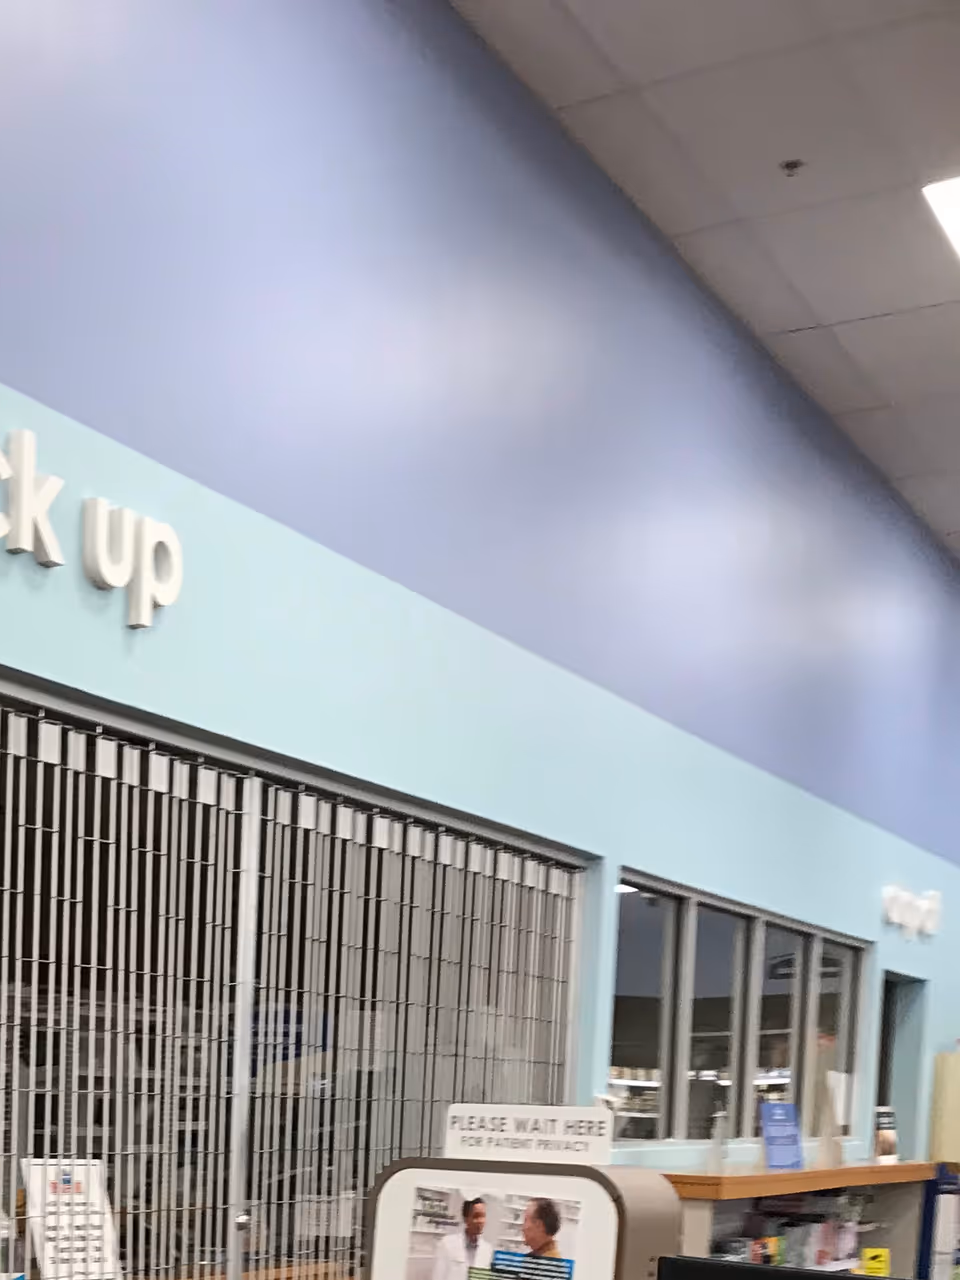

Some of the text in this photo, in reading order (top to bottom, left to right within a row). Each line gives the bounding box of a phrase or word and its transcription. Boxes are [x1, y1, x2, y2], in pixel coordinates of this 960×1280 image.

[82, 496, 183, 629] up
[450, 1115, 607, 1136] PLEASE WAIT HERE
[460, 1135, 589, 1152] FOR PATIENT PRIVACY
